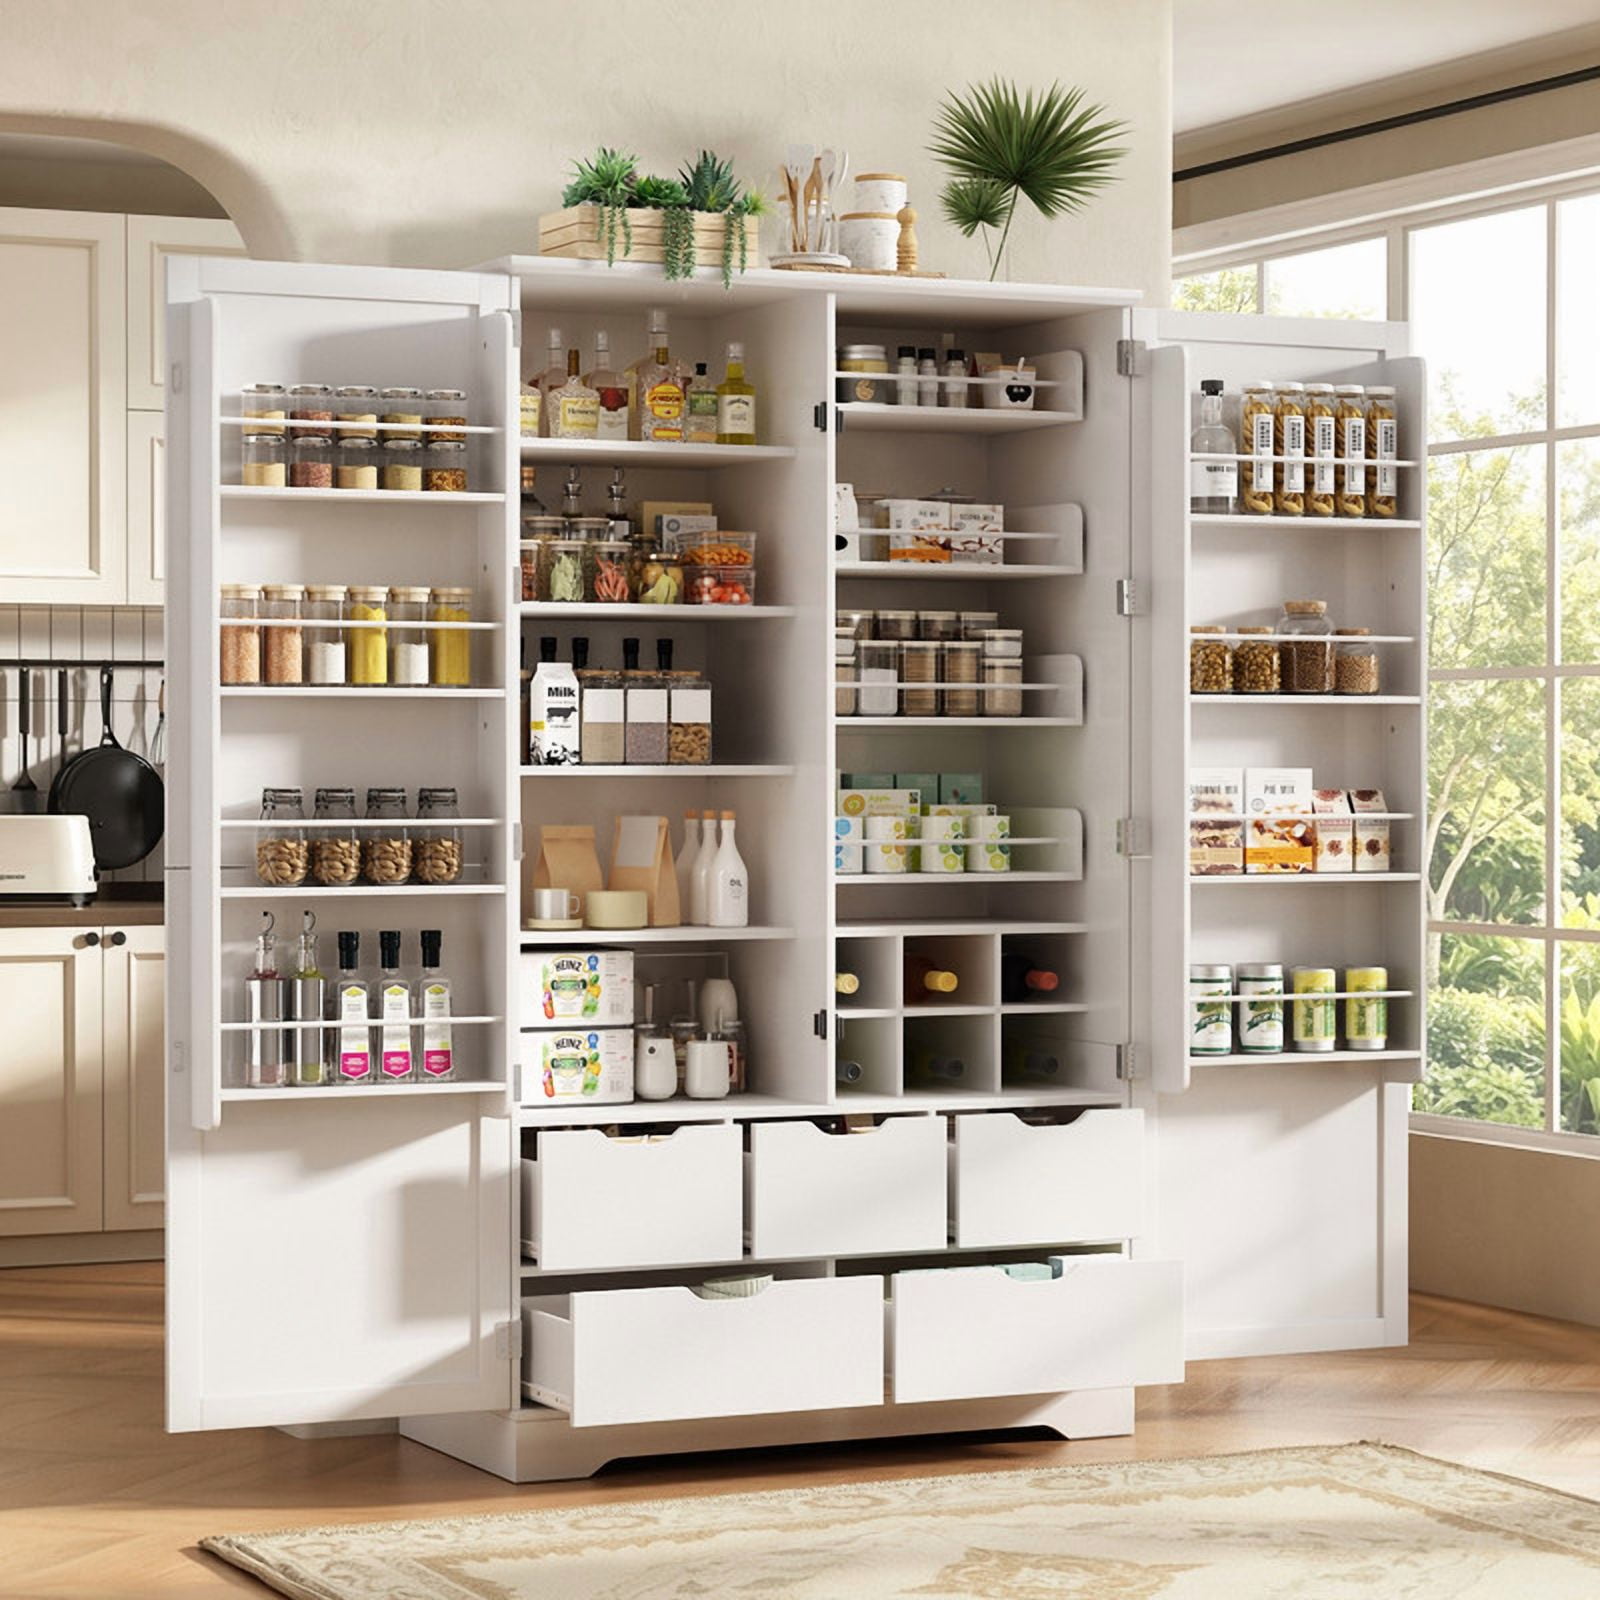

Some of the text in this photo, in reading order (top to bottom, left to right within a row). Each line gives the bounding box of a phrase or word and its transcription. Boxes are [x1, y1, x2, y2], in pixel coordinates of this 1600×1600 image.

[547, 686, 576, 697] Milk
[1263, 784, 1295, 795] PIE MIX
[554, 960, 583, 973] HEINZ
[554, 1038, 583, 1050] HEINZ
